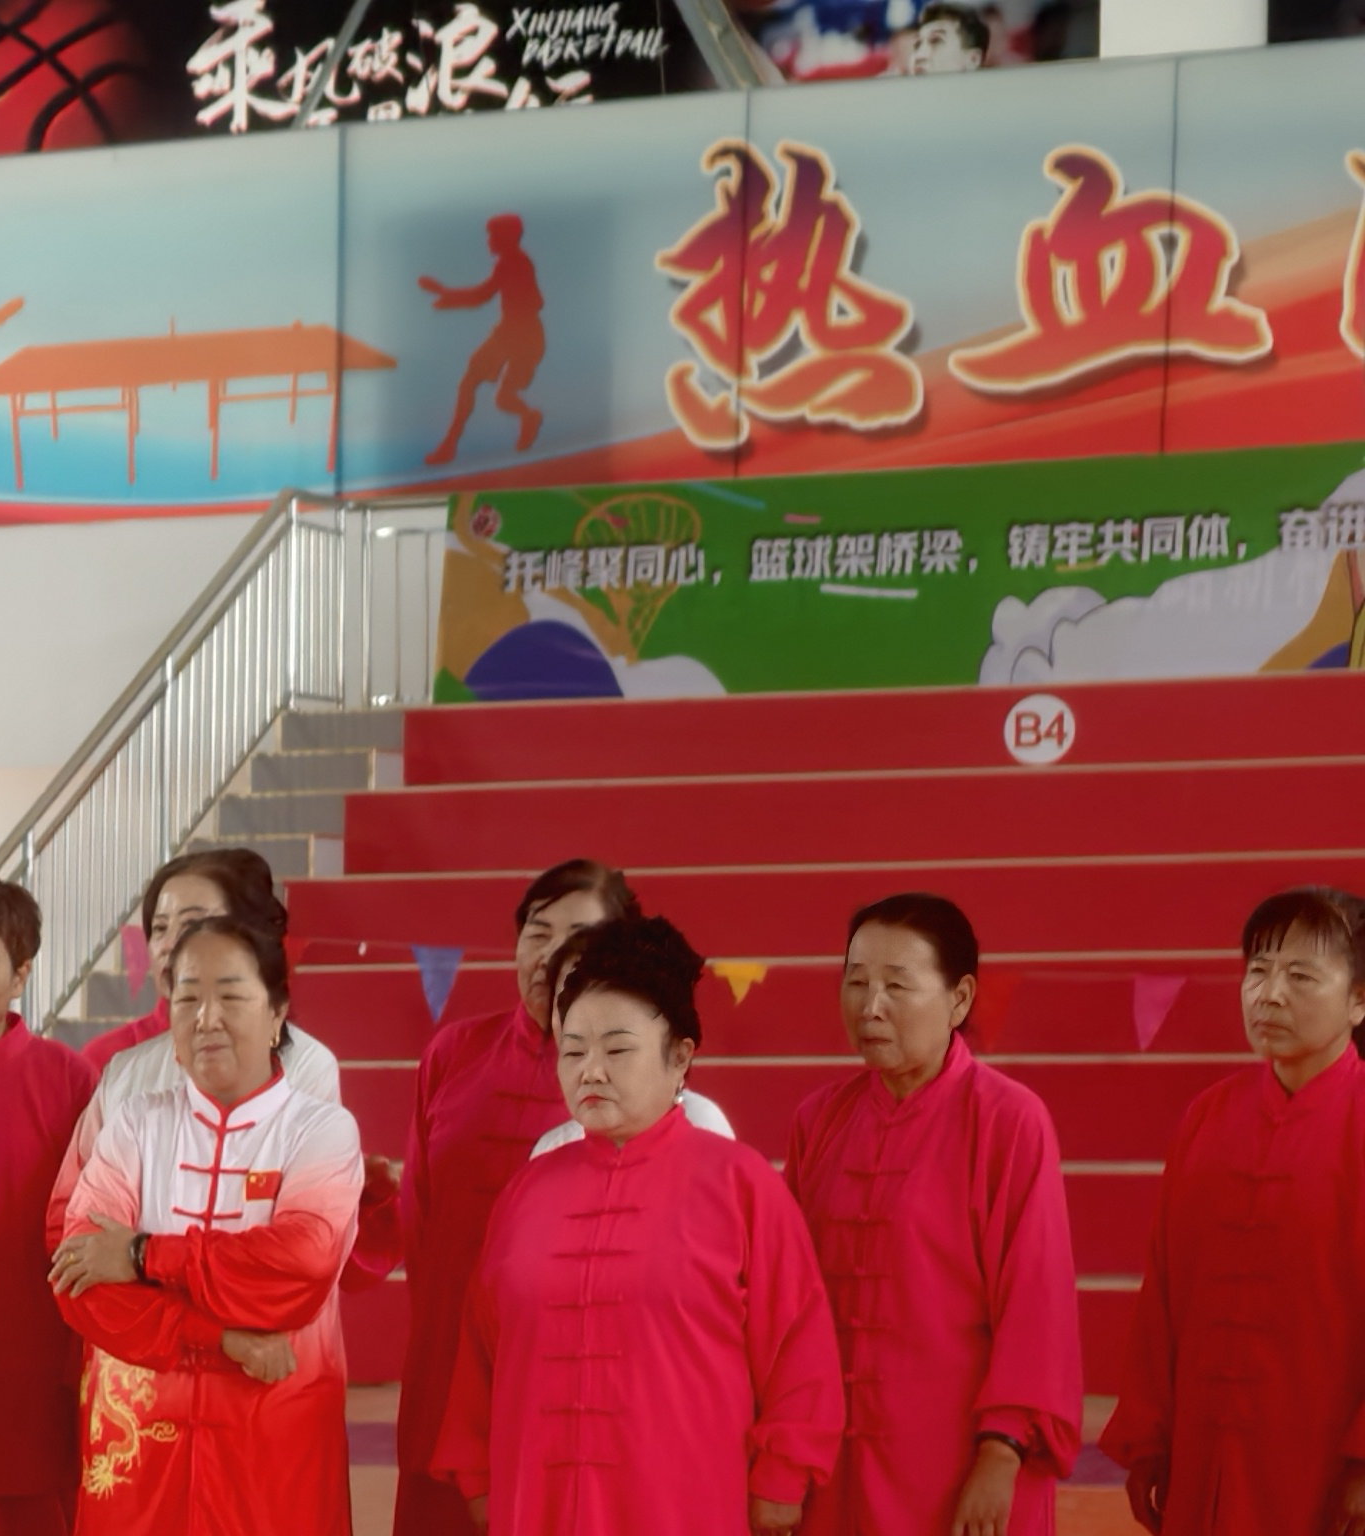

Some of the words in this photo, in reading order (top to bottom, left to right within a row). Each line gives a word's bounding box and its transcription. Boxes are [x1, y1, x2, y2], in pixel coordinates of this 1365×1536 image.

[505, 2, 620, 42] XINJIANG
[521, 26, 669, 71] BASKETBALL
[655, 137, 1365, 452] 热血
[1013, 708, 1068, 750] B4
